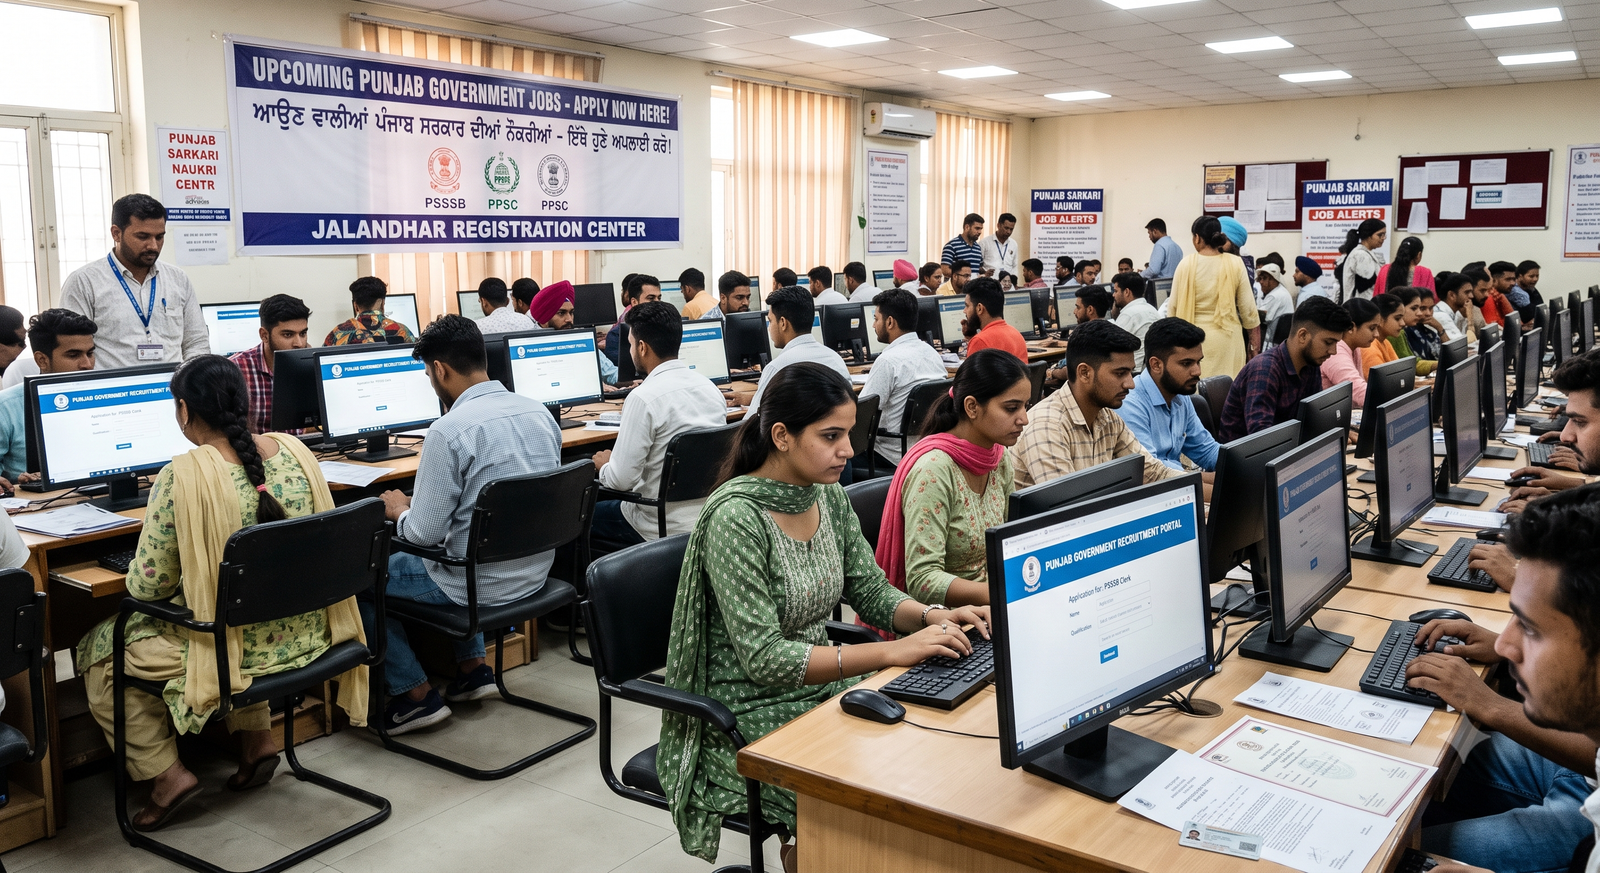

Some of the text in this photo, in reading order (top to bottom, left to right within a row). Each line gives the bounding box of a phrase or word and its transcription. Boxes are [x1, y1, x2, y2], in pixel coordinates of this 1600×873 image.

[253, 56, 353, 91] UPCOMING
[359, 69, 424, 98] PUNJAB
[429, 77, 525, 108] GOVERNMENT
[529, 89, 561, 113] JOBS
[574, 95, 608, 117] APPLY
[612, 100, 637, 120] NOW
[640, 103, 670, 124] HERE!
[253, 98, 305, 130] ਆਉਣ
[312, 103, 368, 130] ਵਾਲੀਆਂ
[375, 106, 414, 134] ਪੰਜਾਬ
[420, 117, 465, 137] ਸਰਕਾਰ
[470, 116, 501, 140] ਦੀਆਂ
[612, 132, 650, 152] ਅਪਲਾਈ
[169, 133, 216, 146] PUNJAB
[168, 148, 219, 160] SARKARI
[172, 164, 217, 175] NAUKRI
[175, 179, 215, 190] CENTR
[1306, 181, 1390, 194] PUNJAB SARKARI
[1034, 191, 1101, 200] PUNJAB SARKARI
[1328, 194, 1365, 205] NAUKRI
[425, 197, 466, 209] PSSSB
[488, 199, 518, 210] PPSC
[541, 200, 569, 211] PPSC
[1052, 202, 1082, 211] NAUKRI
[1038, 215, 1094, 223] JOB ALERTS
[1312, 209, 1381, 220] JOB ALERTS
[311, 219, 646, 239] JALANDHAR REGISTRATION CENTER
[72, 395, 93, 403] PUNJAB
[94, 391, 128, 400] GOVERNMENT
[1045, 518, 1182, 572] PUNJAB GOVERNMENT RECRUITMENT PORTAL
[1068, 589, 1094, 603] Application
[1119, 575, 1131, 585] Clerk
